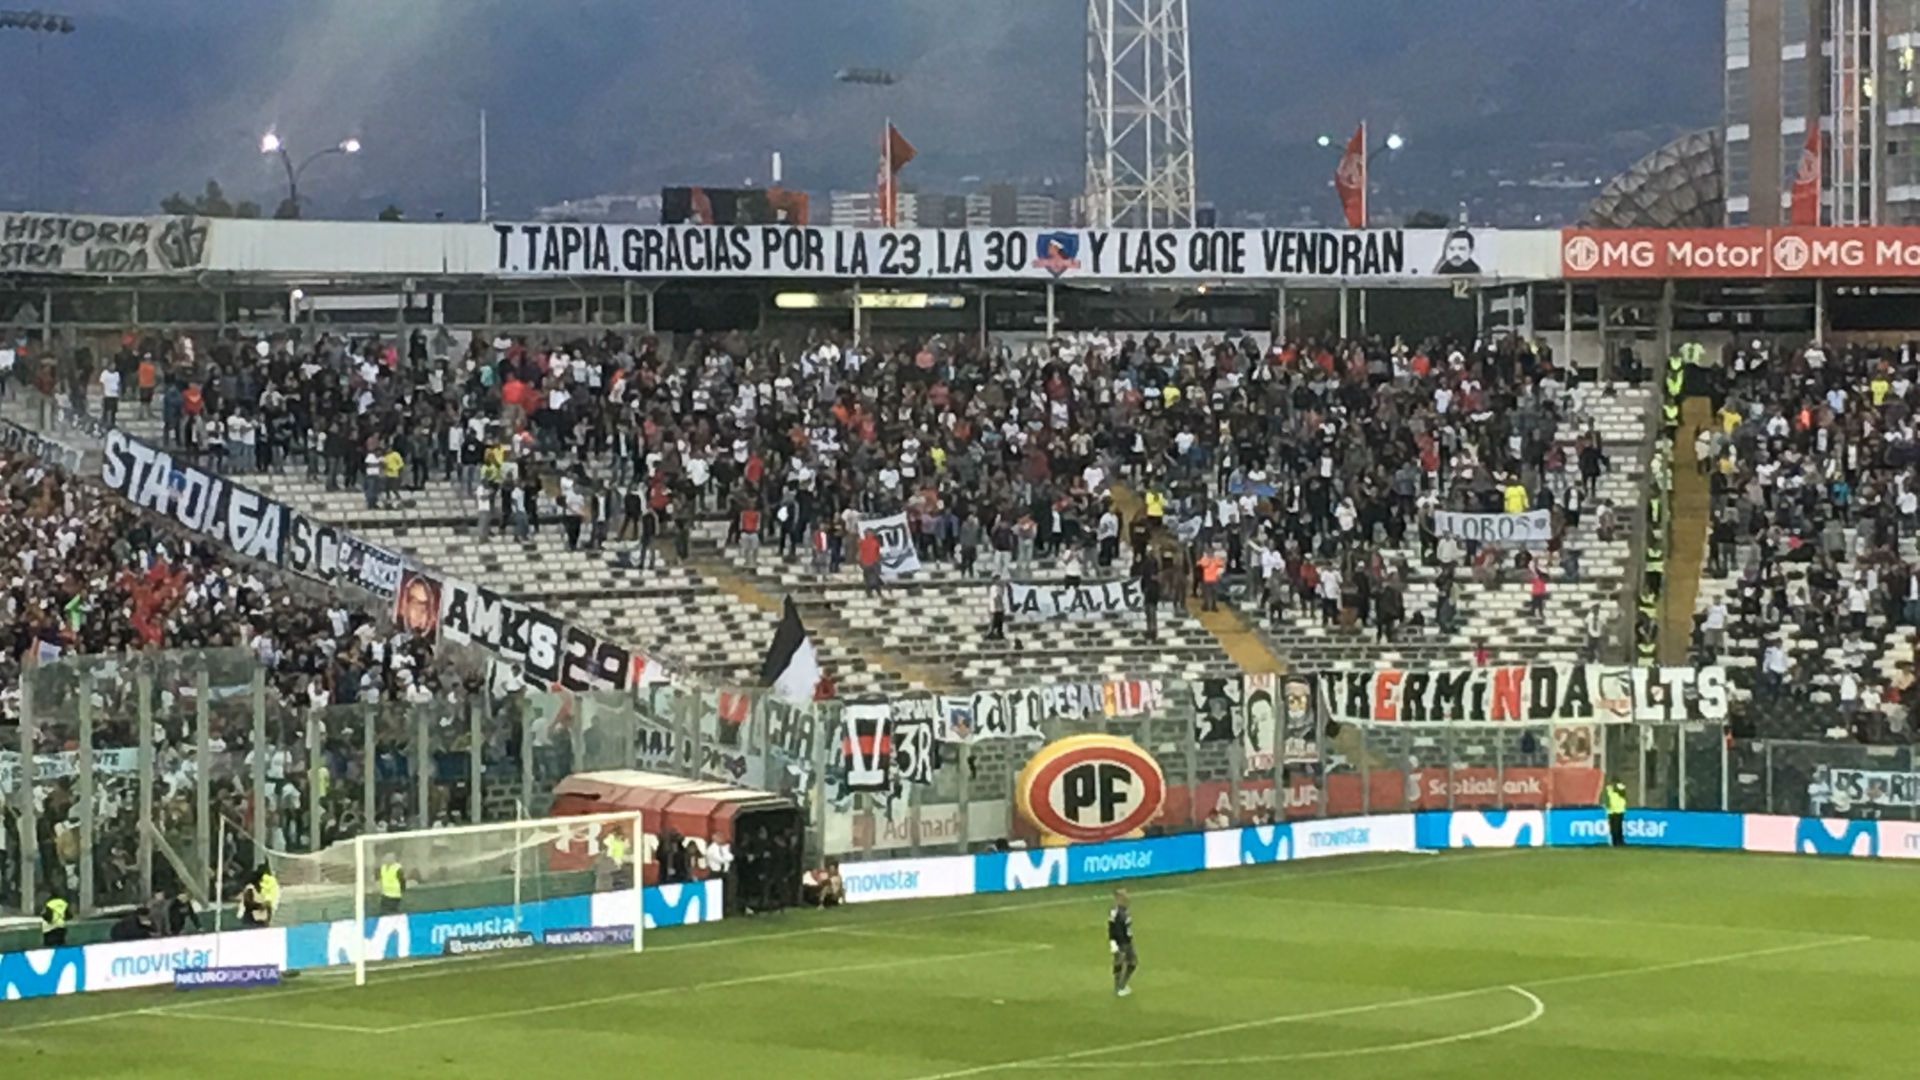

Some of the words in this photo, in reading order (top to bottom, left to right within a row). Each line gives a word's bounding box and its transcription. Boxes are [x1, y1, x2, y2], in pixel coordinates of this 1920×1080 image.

[4, 215, 150, 244] HISTORIA
[86, 248, 148, 272] VIDA
[622, 226, 751, 271] GRACIAS
[762, 228, 824, 270] POR
[834, 230, 868, 274] LA
[937, 231, 972, 274] LA
[984, 230, 1026, 272] 30
[1087, 231, 1107, 273] Y
[1118, 231, 1178, 273] LAS
[1602, 241, 1655, 267] MG
[1667, 240, 1763, 267] Motor
[1812, 240, 1864, 266] MG
[1007, 582, 1040, 615] LA
[1632, 665, 1729, 721] LTS
[1063, 763, 1131, 823] PF
[1309, 826, 1370, 848] movistar
[1570, 817, 1668, 838] moistar
[1083, 849, 1153, 874] movistar
[844, 870, 920, 894] movistar
[111, 947, 213, 977] movistar
[176, 969, 278, 984] NEUROBIONTA
